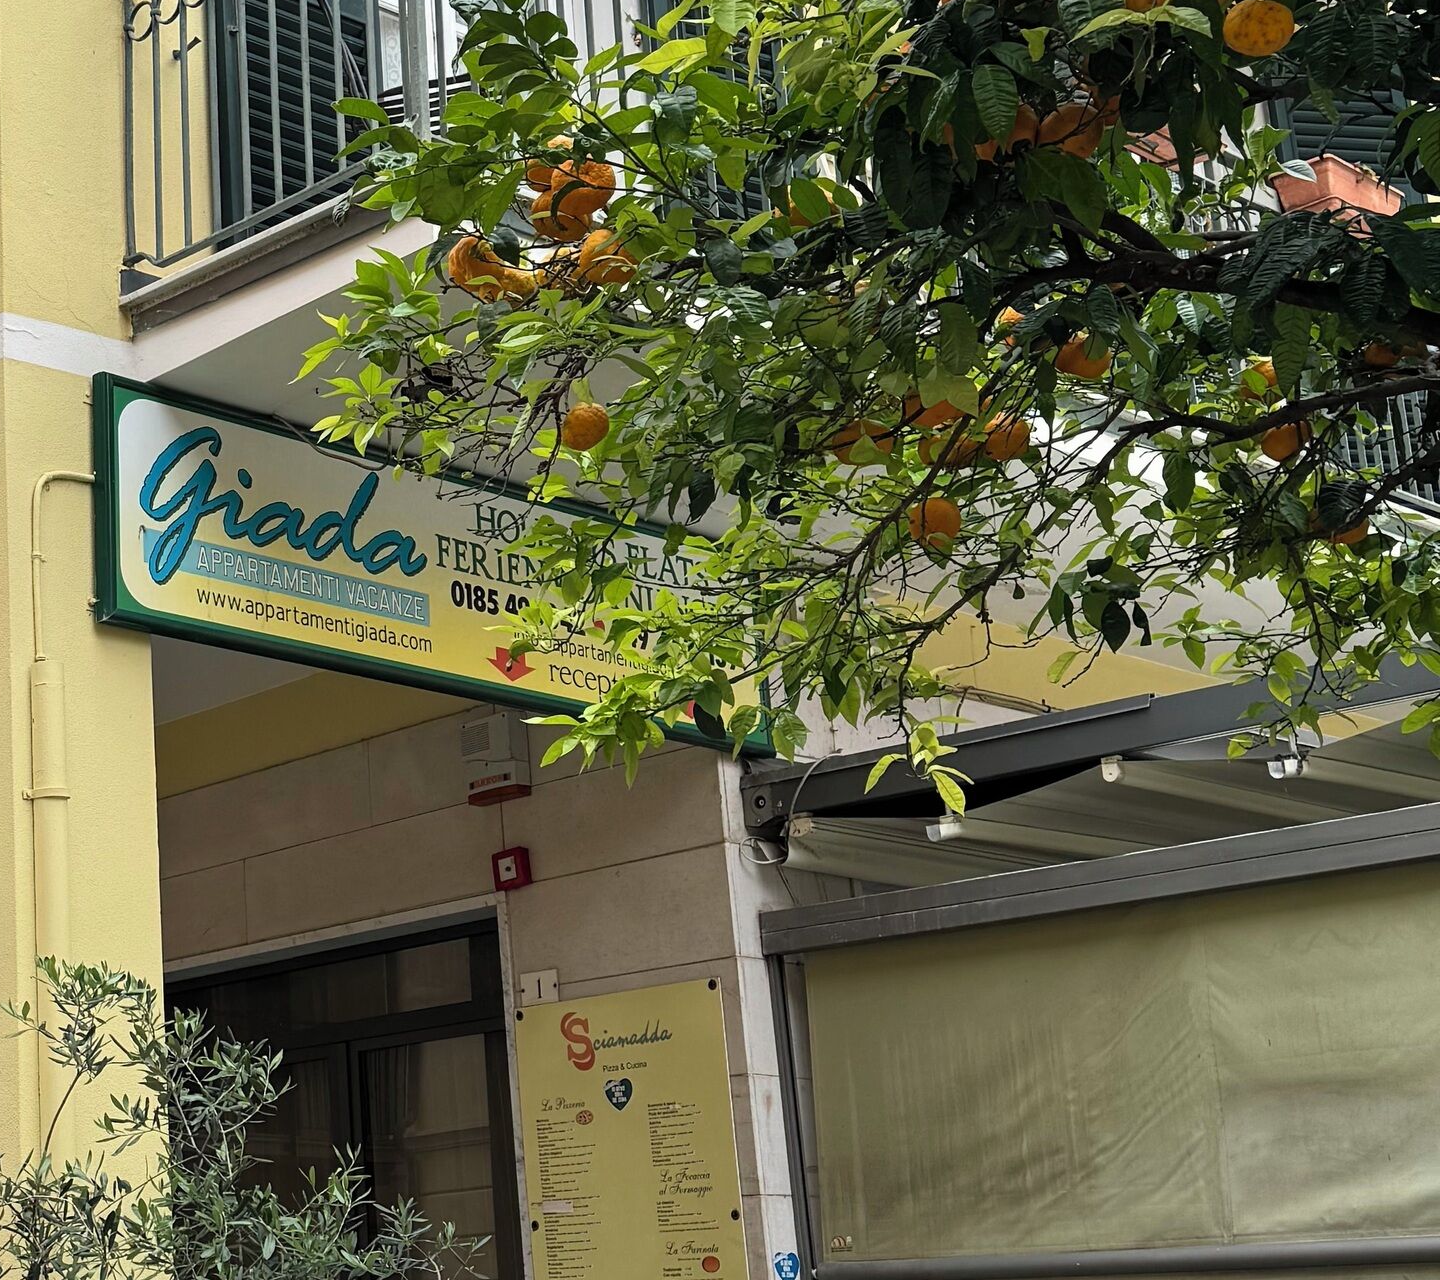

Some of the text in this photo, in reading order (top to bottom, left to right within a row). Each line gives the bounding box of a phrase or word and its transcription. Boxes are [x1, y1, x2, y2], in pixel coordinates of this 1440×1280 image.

[138, 426, 429, 585] Giada
[196, 543, 427, 622] APPARTAMENTI VACANZE
[451, 580, 500, 616] 0185
[196, 586, 434, 654] www.appartamentigiada.com
[537, 978, 543, 999] 1
[560, 1011, 673, 1072] Sciamadda
[602, 1065, 620, 1073] Pizza
[626, 1061, 648, 1070] Cucina
[660, 1169, 672, 1183] La
[665, 1240, 678, 1255] La
